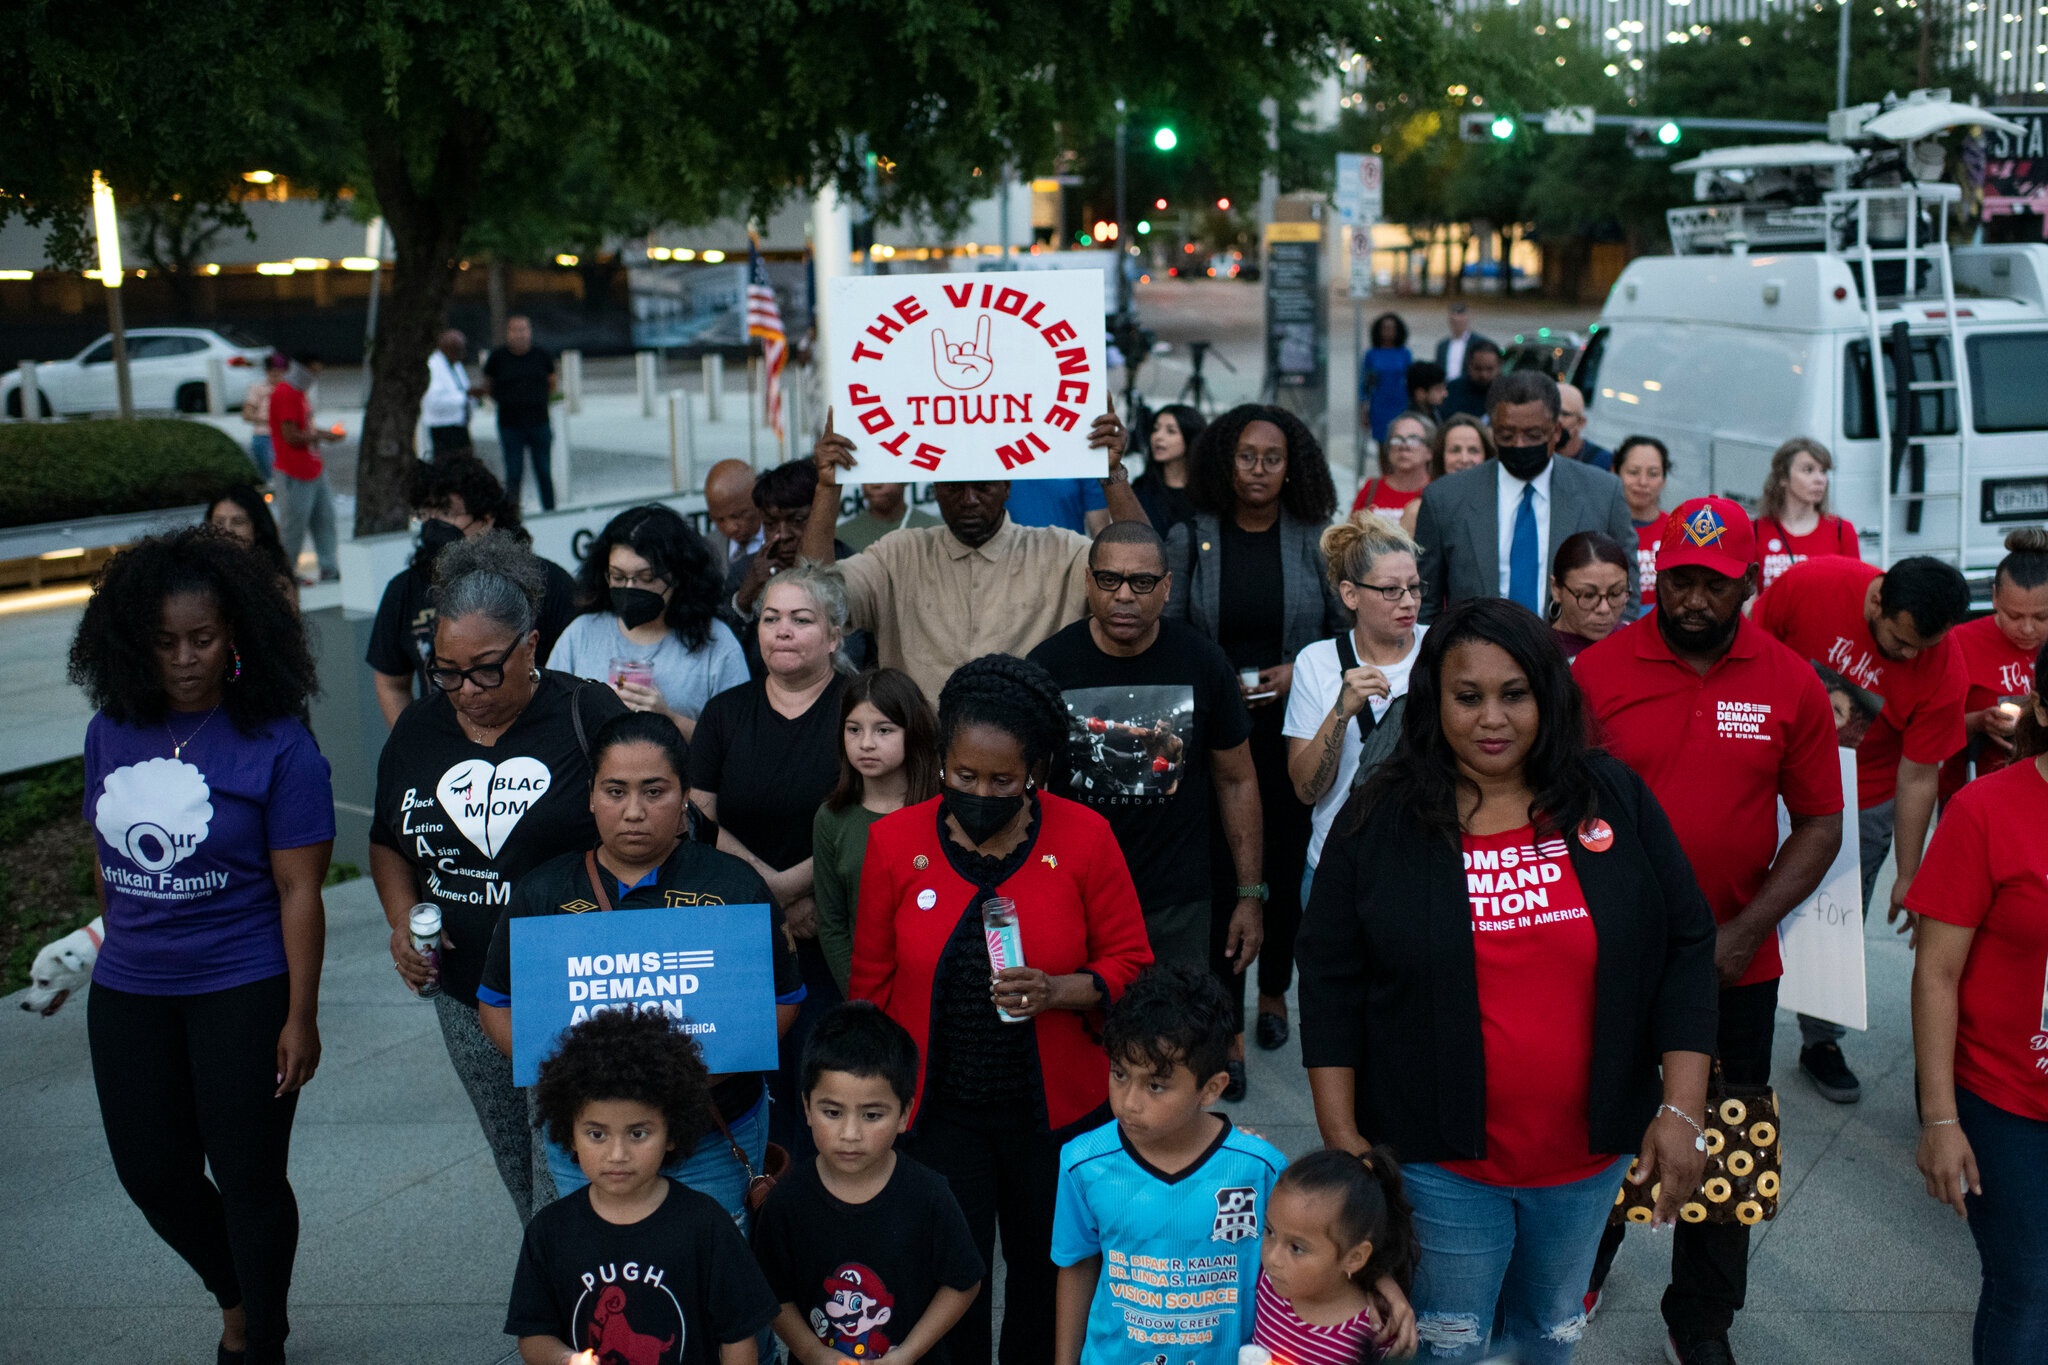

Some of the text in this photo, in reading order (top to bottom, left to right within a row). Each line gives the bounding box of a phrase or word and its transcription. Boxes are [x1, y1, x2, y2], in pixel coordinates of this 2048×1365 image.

[1994, 116, 2044, 158] STA
[848, 283, 1090, 471] STOP THE VIOLENCE IN
[907, 393, 1032, 426] TOWN
[1828, 636, 1854, 675] Fly
[1999, 662, 2031, 695] Fly
[1717, 701, 1751, 712] DADS
[1717, 711, 1765, 723] DEMAND
[1718, 722, 1759, 733] ACTION
[401, 788, 434, 812] Black
[464, 801, 529, 818] MOM
[1078, 794, 1173, 805] LEGENDAR
[402, 811, 444, 835] Latino
[126, 822, 197, 874] Our
[416, 836, 461, 857] Asian
[159, 870, 229, 892] Family
[437, 858, 500, 880] Caucasian
[1467, 863, 1562, 893] MAND
[115, 885, 212, 900] www.ourafrikanfamily.org
[469, 892, 484, 905] Of
[1469, 887, 1549, 917] TION
[1479, 918, 1516, 931] SENSE
[1518, 916, 1531, 928] IN
[1534, 907, 1588, 925] AMERICA
[1814, 891, 1854, 926] for
[567, 952, 661, 977] MOMS
[569, 974, 699, 1002] DEMAND
[1109, 1250, 1237, 1271] DR. DIPAK R. KALANI
[581, 1262, 664, 1292] PUGH
[1109, 1265, 1238, 1287] DR. LINDA S. HAIDAR
[1109, 1283, 1238, 1309] VISION SOURCE
[1124, 1310, 1219, 1329] SHADOW CREEK
[1127, 1326, 1212, 1345] 713-436-7544
